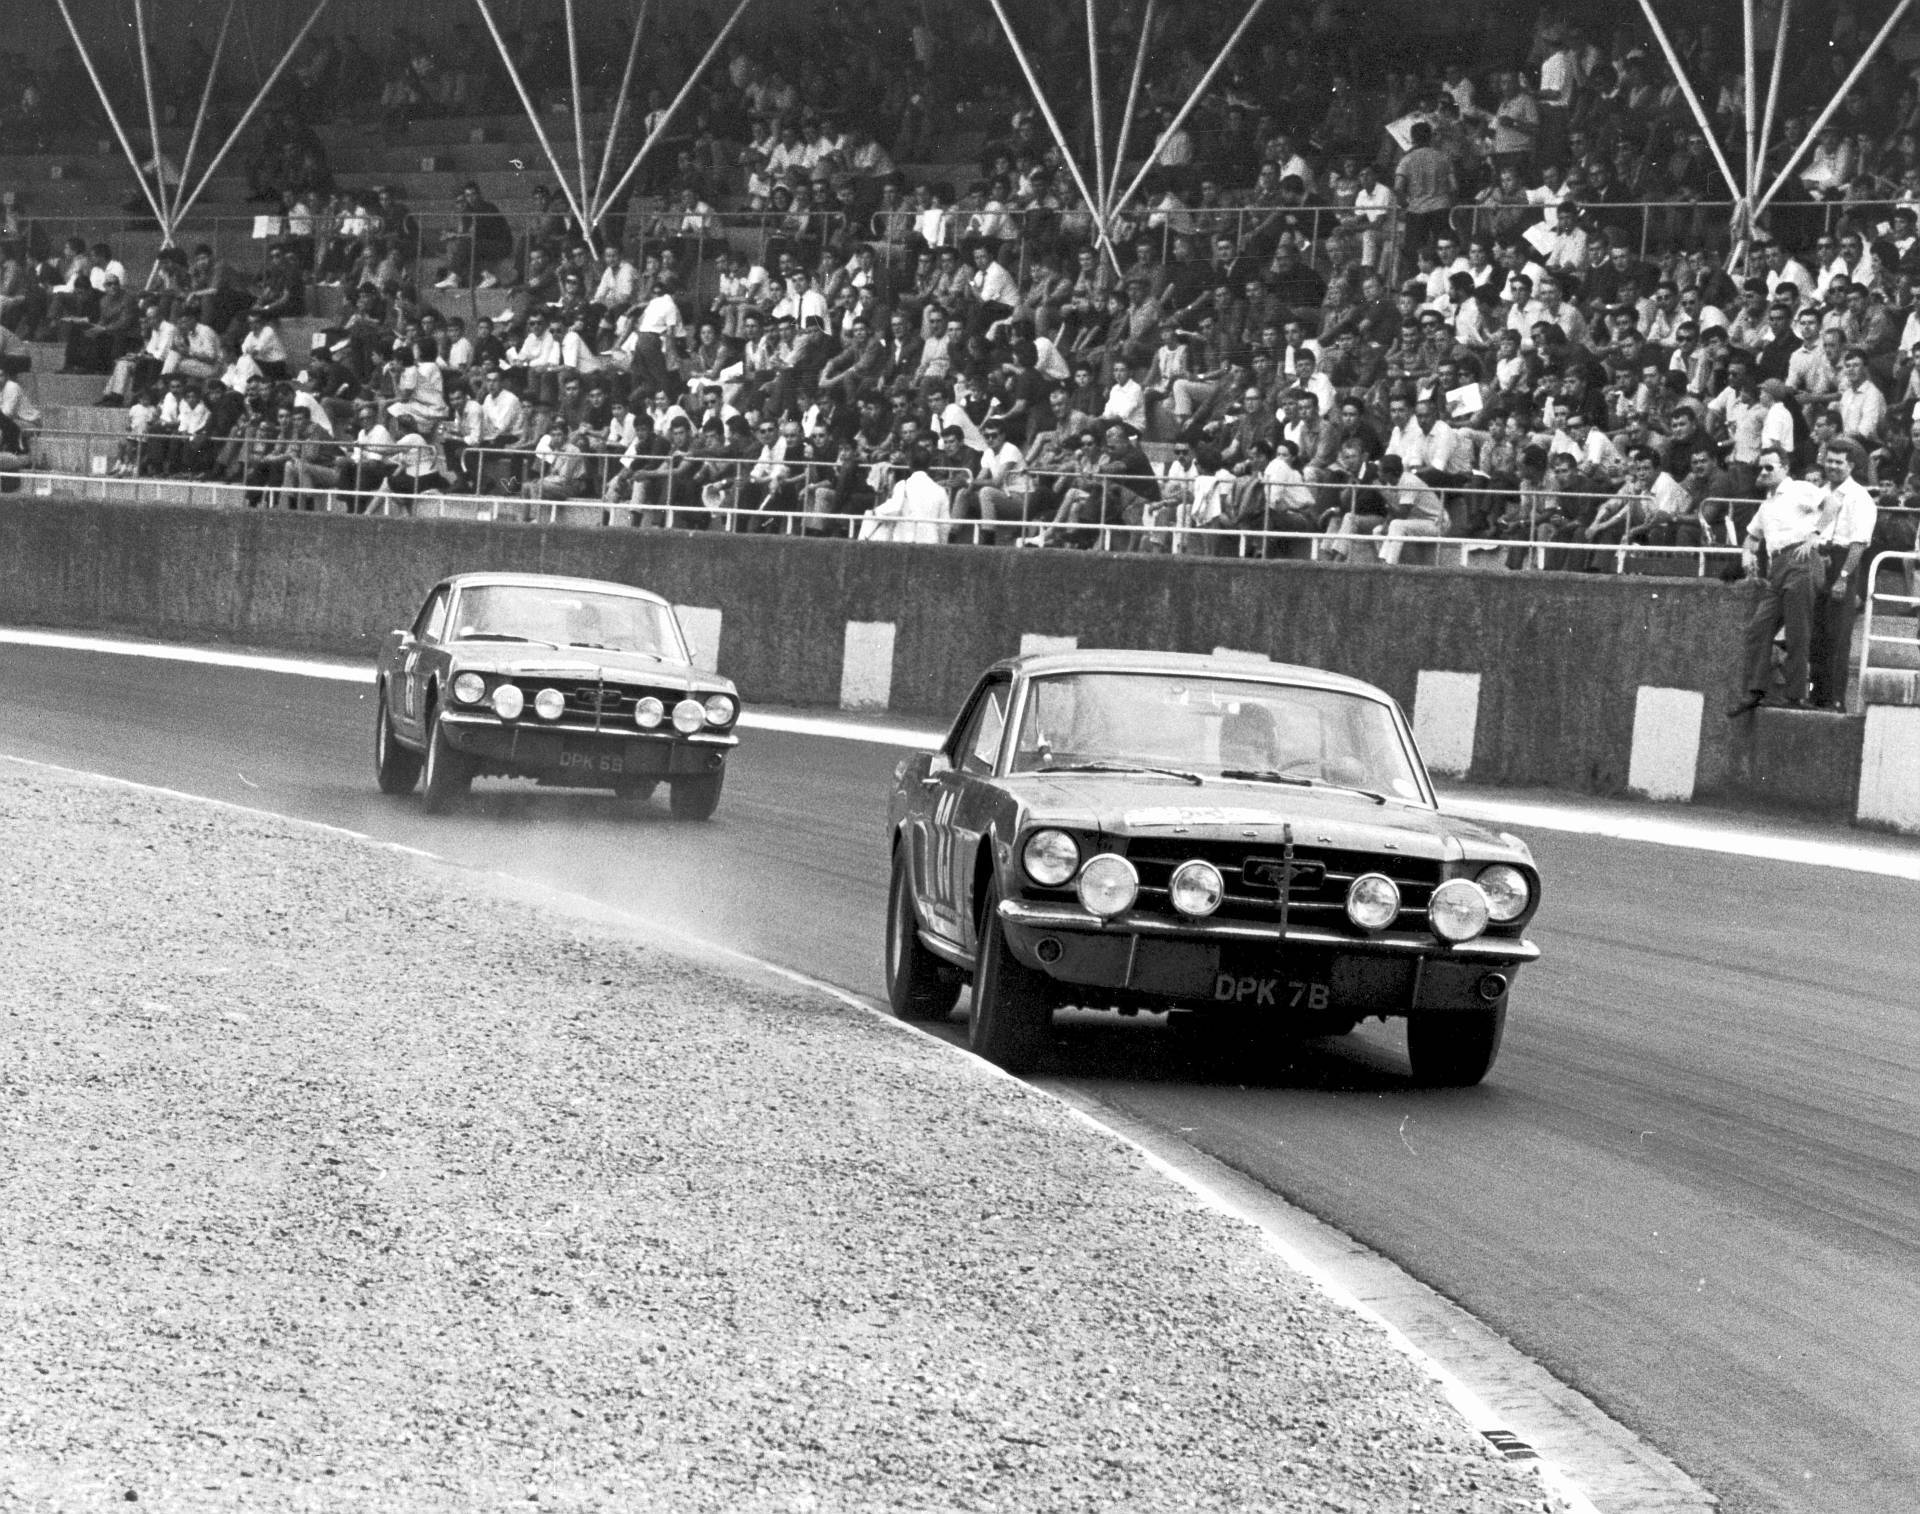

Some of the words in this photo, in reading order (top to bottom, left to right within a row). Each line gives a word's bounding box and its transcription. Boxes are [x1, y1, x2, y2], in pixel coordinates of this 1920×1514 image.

[560, 752, 594, 770] DPK
[1215, 974, 1277, 1005] DPK
[1288, 981, 1330, 1010] 7B
